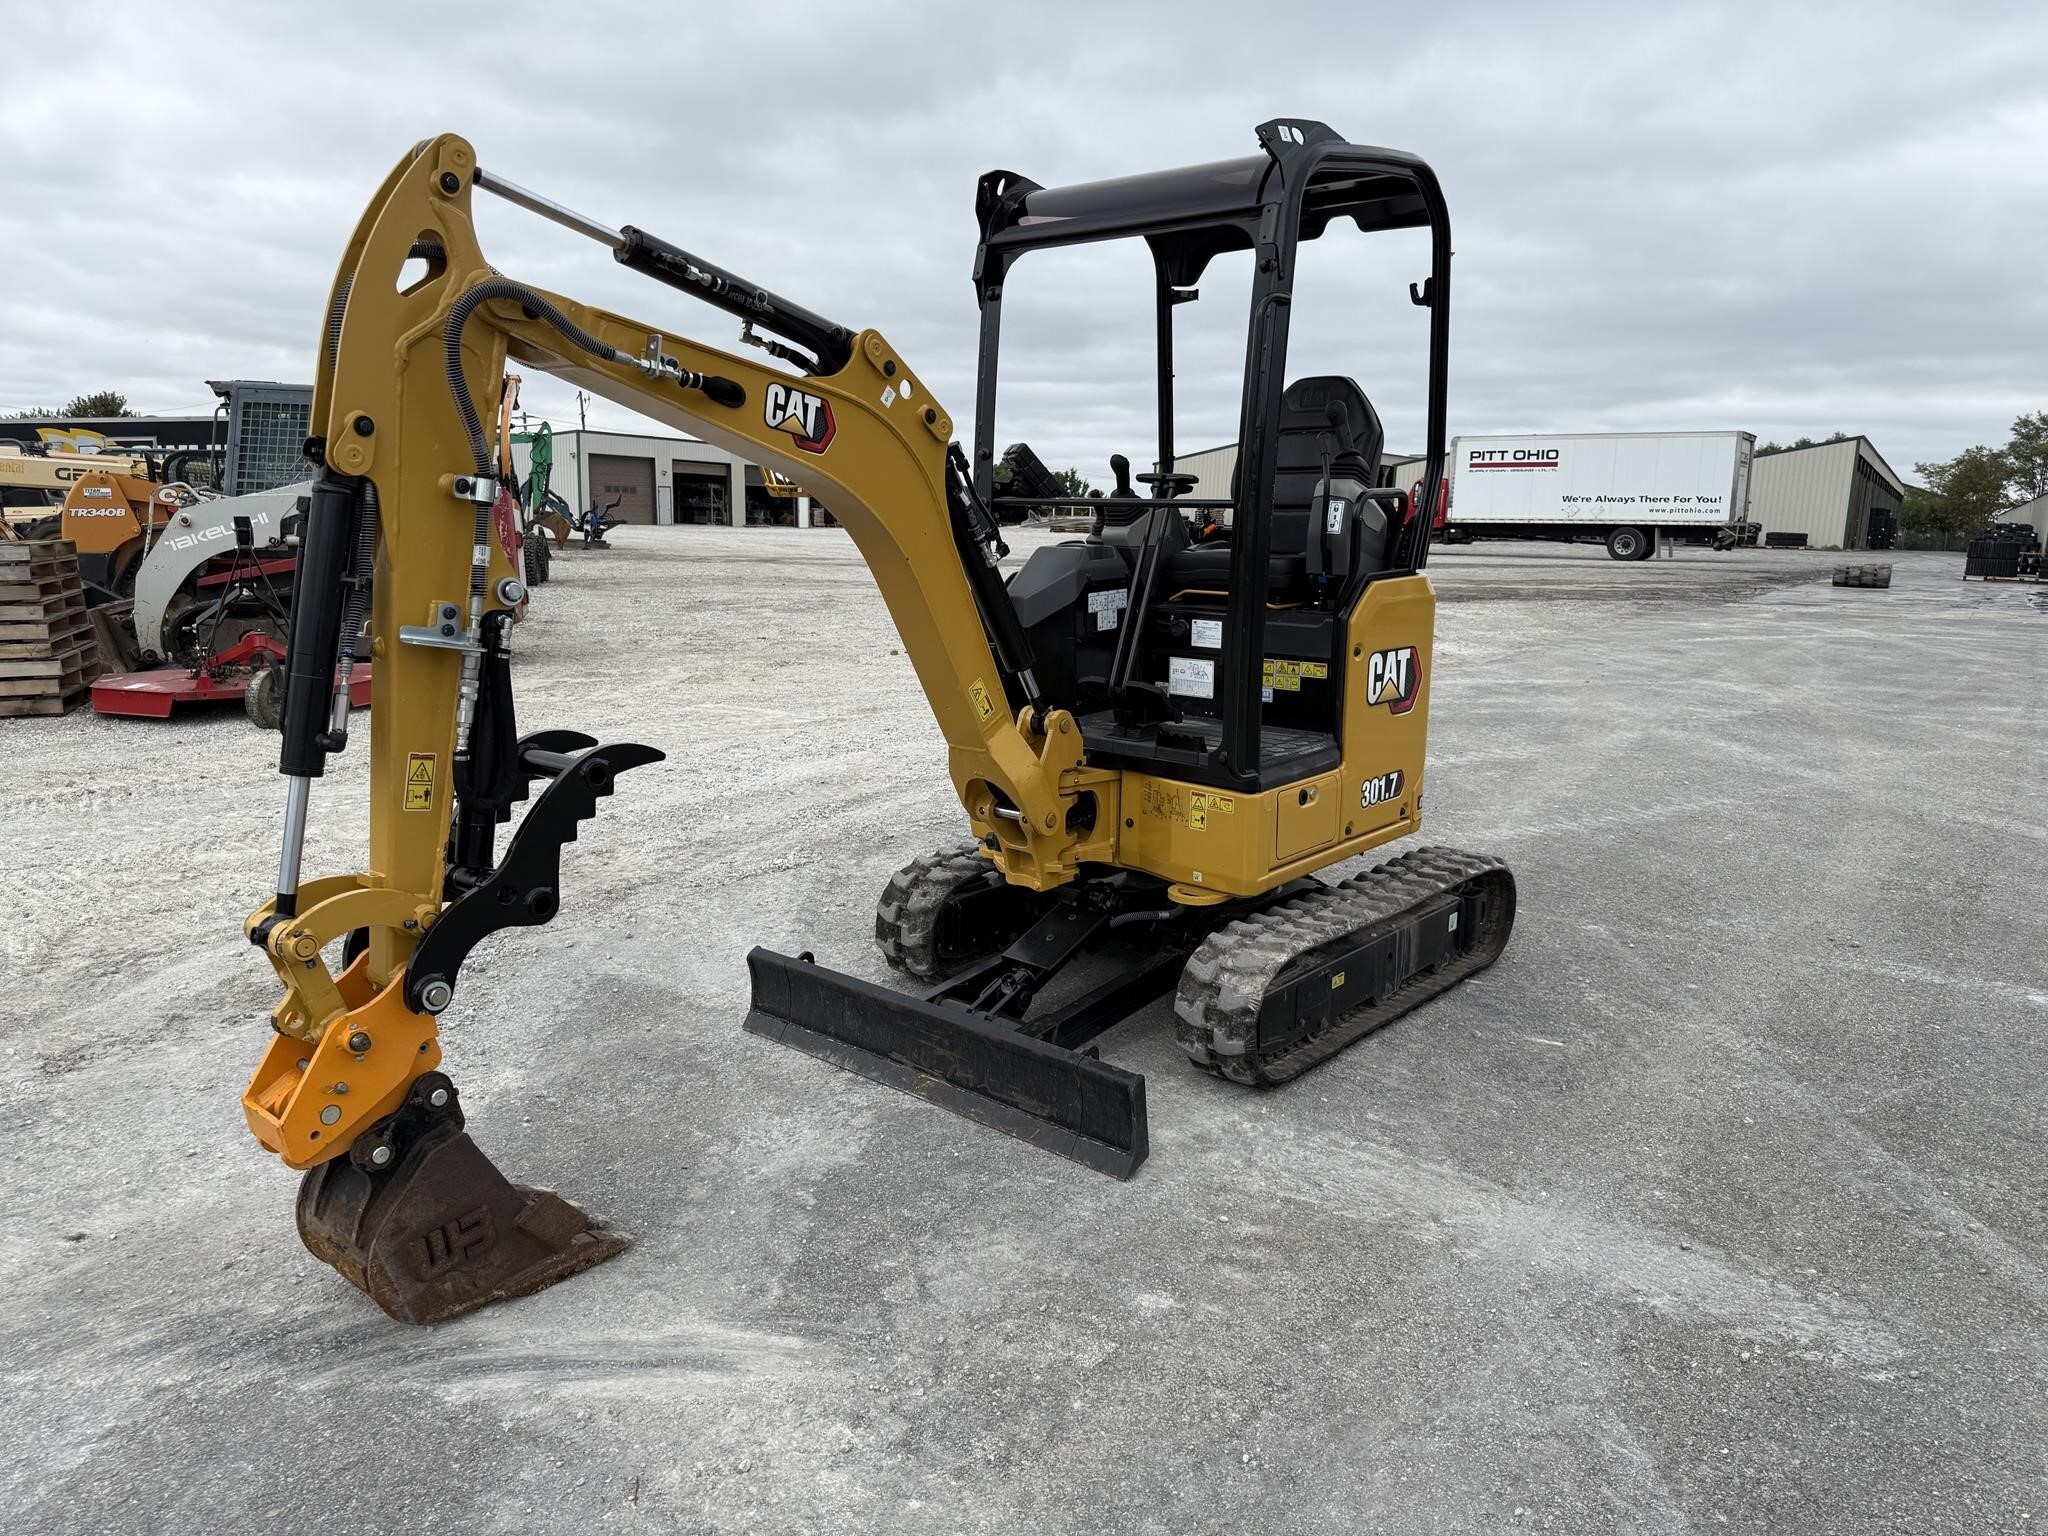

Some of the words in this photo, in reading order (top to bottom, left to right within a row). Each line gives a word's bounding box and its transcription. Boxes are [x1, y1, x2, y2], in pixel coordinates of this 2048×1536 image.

[766, 384, 821, 439] CAT
[1470, 451, 1508, 461] PITT
[1513, 449, 1559, 460] OHIO
[1562, 495, 1592, 503] We're
[1595, 495, 1636, 505] Always
[1639, 495, 1670, 503] There
[1673, 495, 1692, 503] For
[1696, 495, 1722, 504] You!
[69, 508, 126, 517] TR340B
[1367, 648, 1411, 704] CAT
[1361, 772, 1399, 808] 301.7
